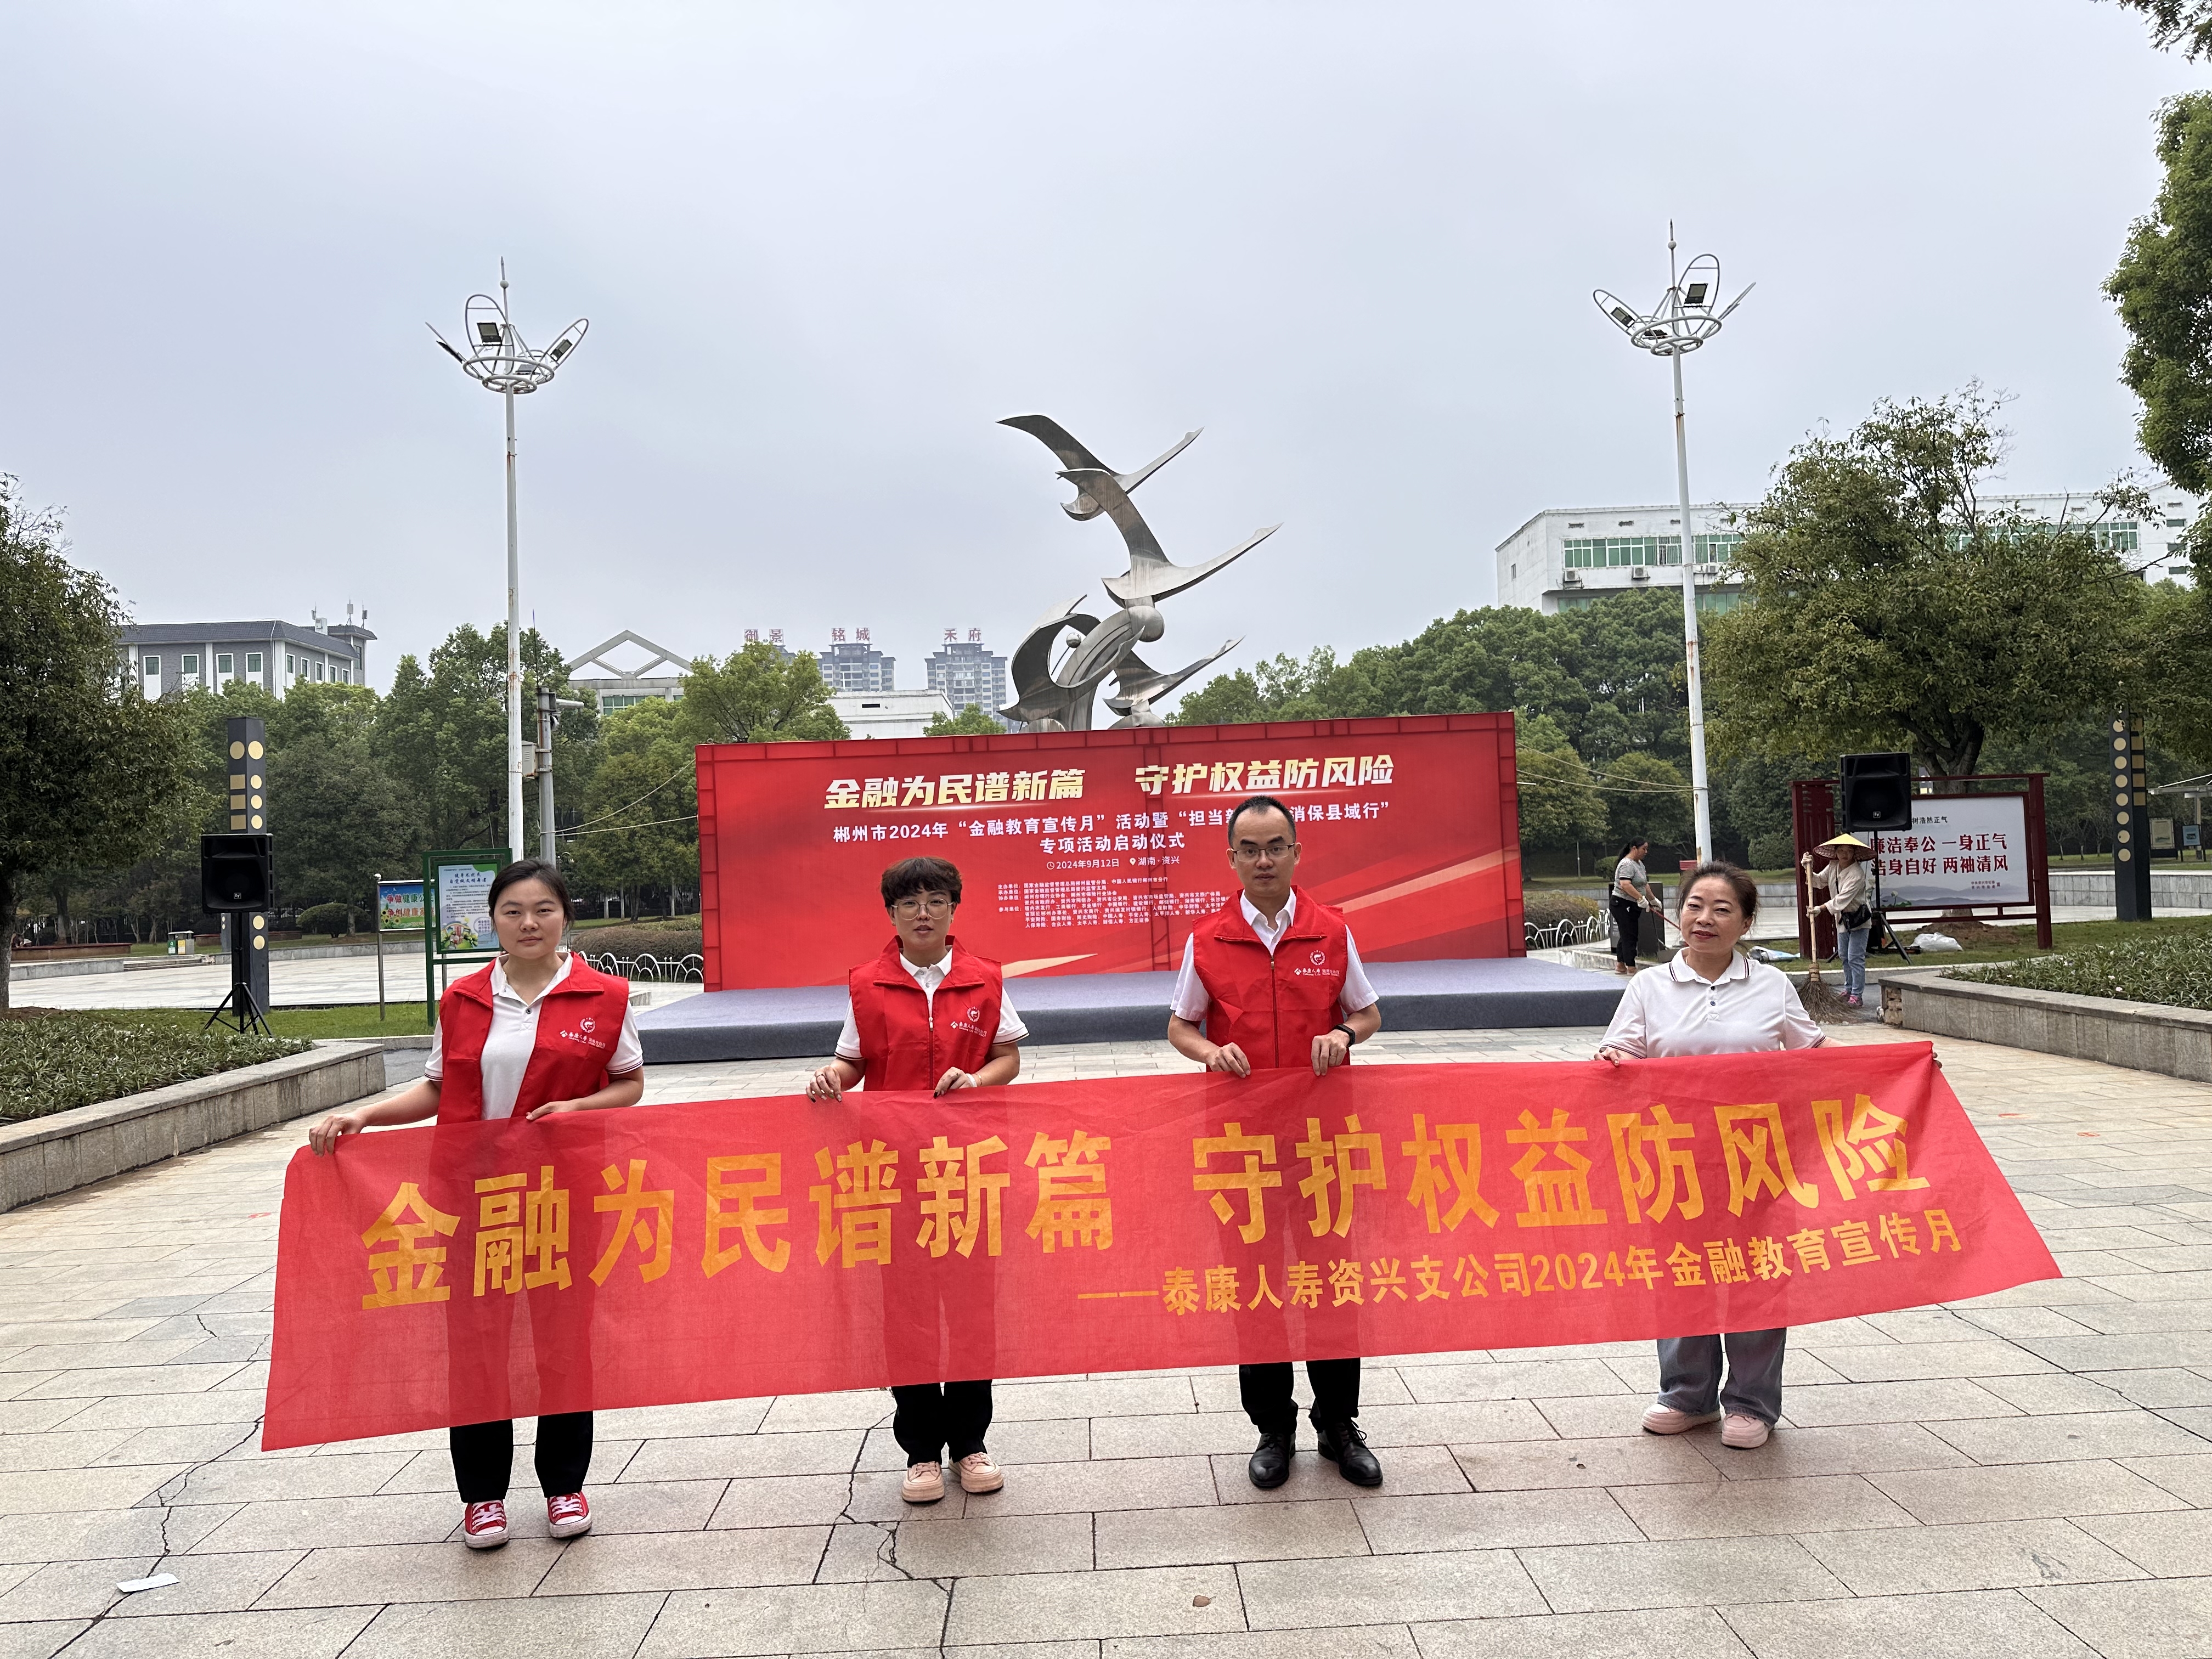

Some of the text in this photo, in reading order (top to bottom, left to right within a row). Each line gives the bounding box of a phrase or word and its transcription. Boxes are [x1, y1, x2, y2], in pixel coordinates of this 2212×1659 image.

[824, 754, 1395, 809] 金融为民谱新篇 守护权益防风险
[1040, 832, 1185, 854] 专项活动启动仪式
[1870, 833, 2007, 854] 廉洁奉公 一身正气
[1056, 858, 1120, 870] 2024年9月12日
[1943, 854, 2008, 874] 两袖清风
[361, 1093, 1929, 1310] 金融为民谱新篇 守护权益防风险
